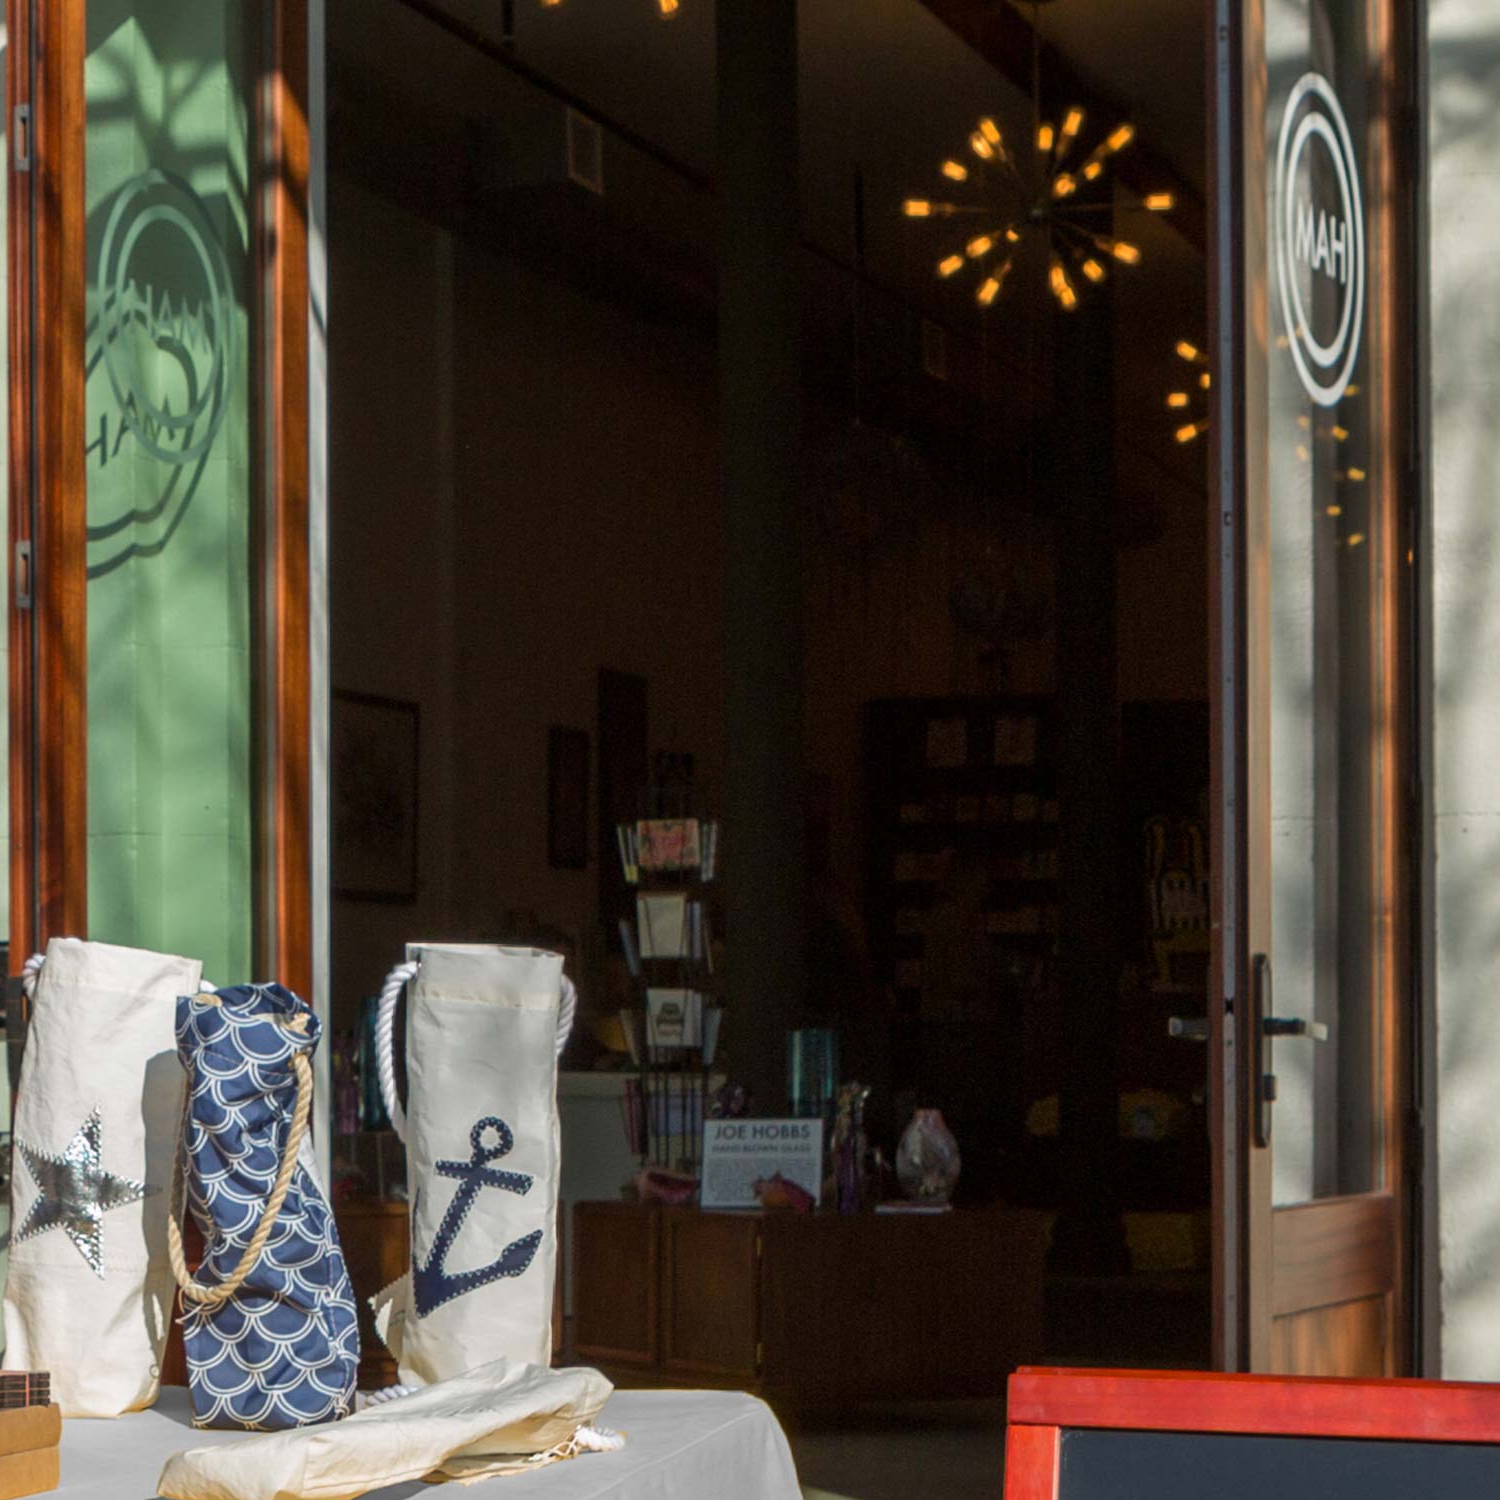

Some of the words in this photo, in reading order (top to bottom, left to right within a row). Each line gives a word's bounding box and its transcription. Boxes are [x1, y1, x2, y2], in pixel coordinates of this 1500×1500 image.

[1296, 198, 1346, 284] MAH
[715, 1124, 746, 1140] JOE
[752, 1124, 810, 1140] HOBBS
